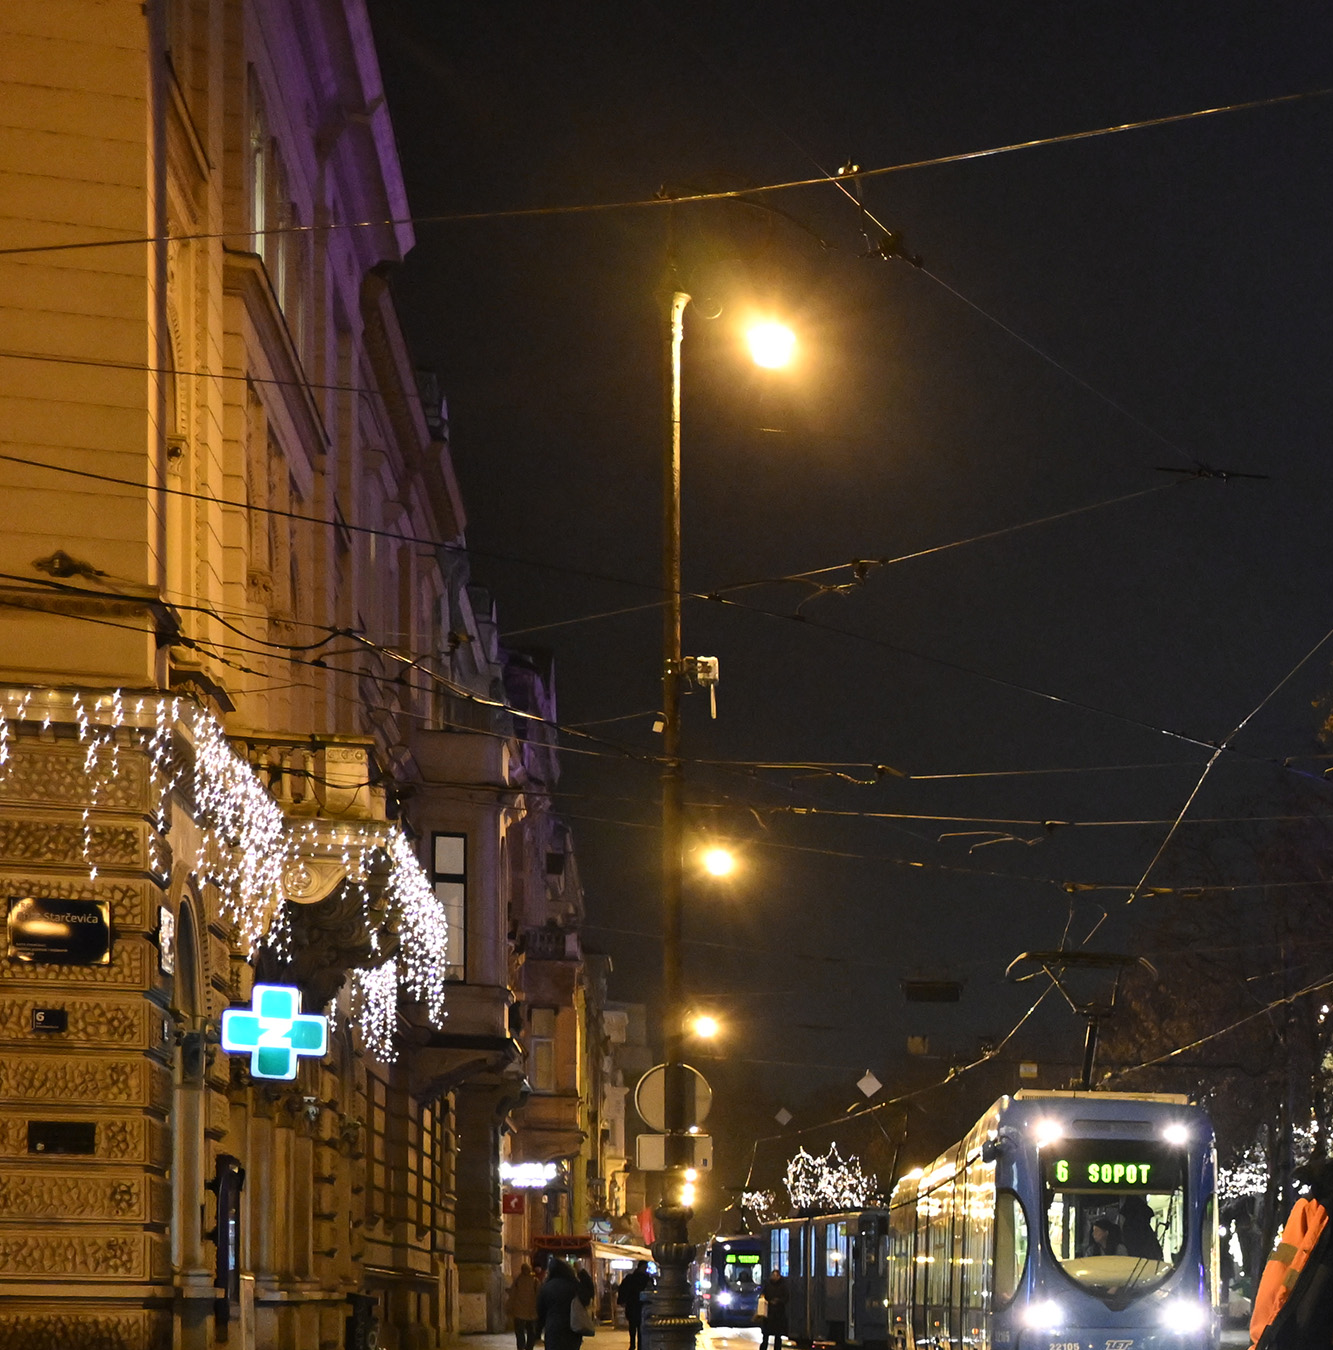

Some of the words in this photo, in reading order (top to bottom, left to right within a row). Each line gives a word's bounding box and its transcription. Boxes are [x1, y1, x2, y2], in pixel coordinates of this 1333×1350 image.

[36, 1011, 45, 1022] 6
[1056, 1159, 1069, 1183] 6
[1087, 1163, 1151, 1184] SOPOT
